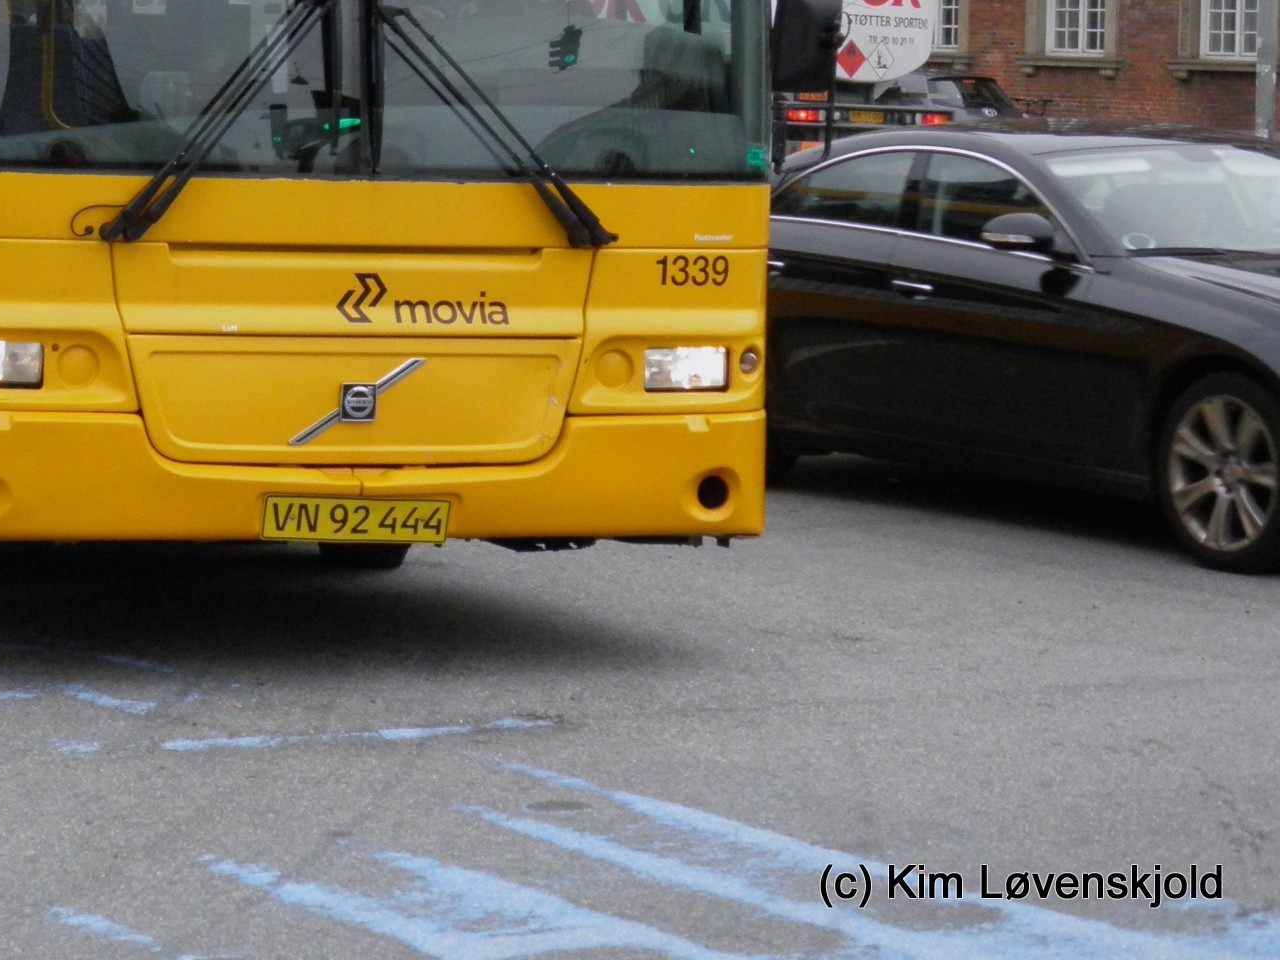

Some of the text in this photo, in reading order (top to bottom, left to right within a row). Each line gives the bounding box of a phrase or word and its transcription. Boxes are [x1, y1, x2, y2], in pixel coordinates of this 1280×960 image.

[848, 14, 891, 27] STØTTER
[656, 254, 729, 287] 1339
[394, 291, 509, 326] movia
[271, 502, 443, 536] VN 92 444
